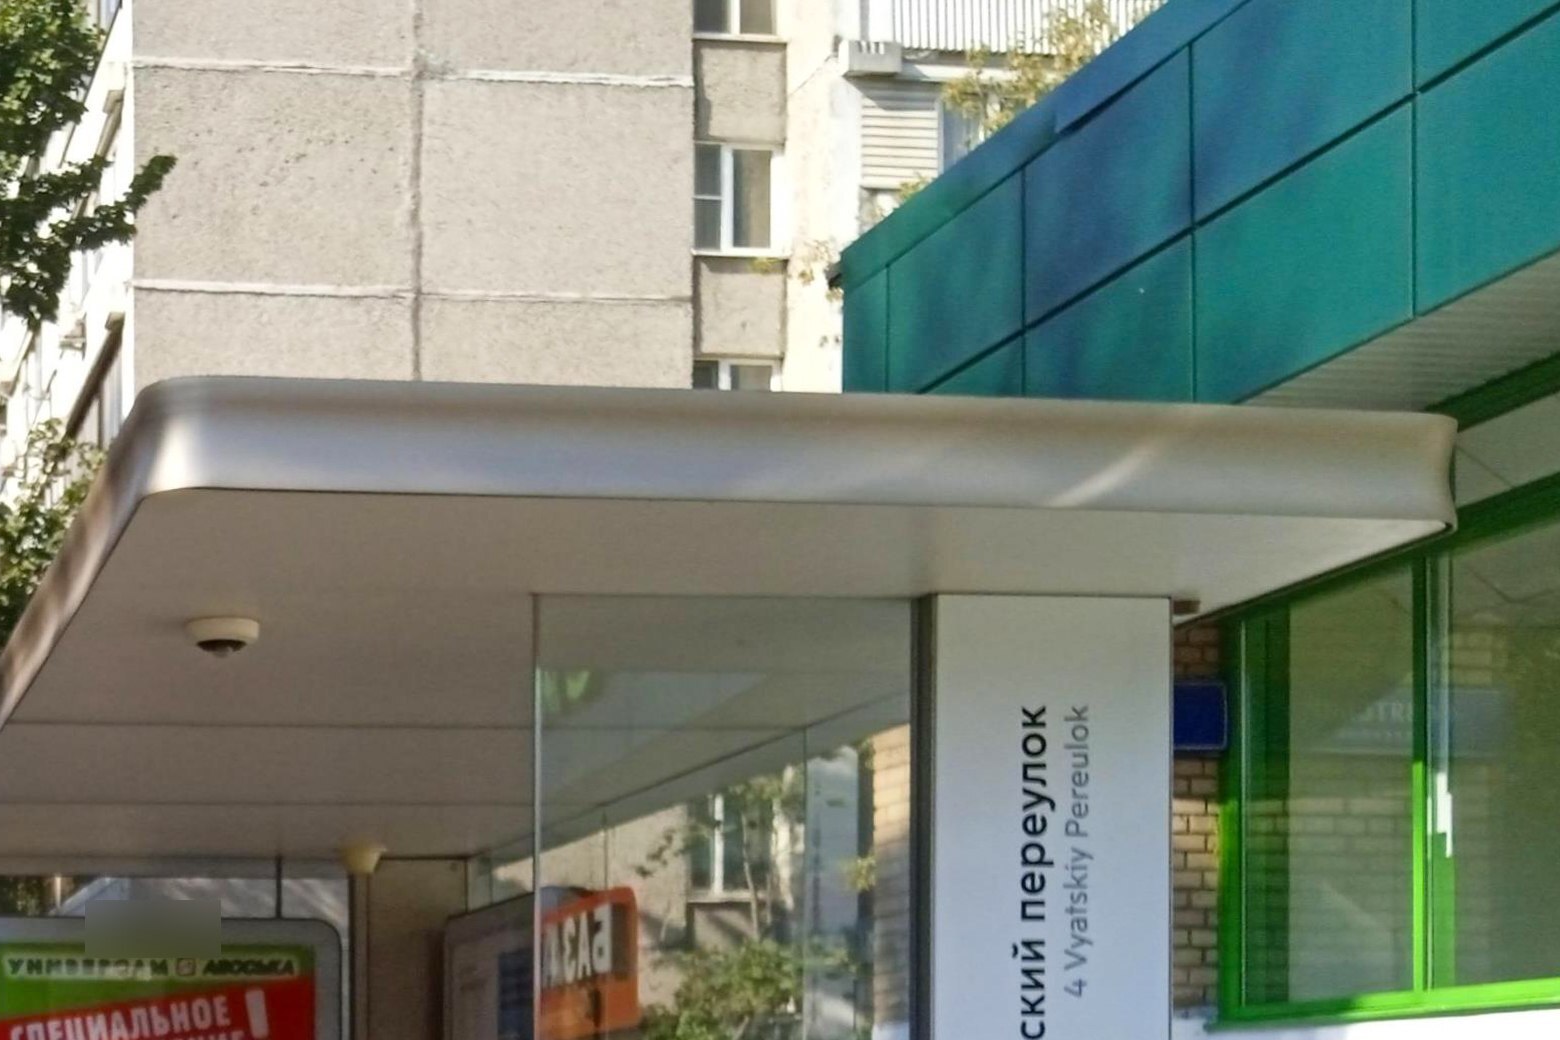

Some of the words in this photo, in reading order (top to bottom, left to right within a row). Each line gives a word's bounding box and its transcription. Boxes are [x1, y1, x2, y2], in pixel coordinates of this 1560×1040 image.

[1020, 704, 1055, 923] переулок
[1063, 704, 1090, 839] Pereulok
[1063, 845, 1094, 959] Vyatskiy
[1063, 979, 1084, 999] 4
